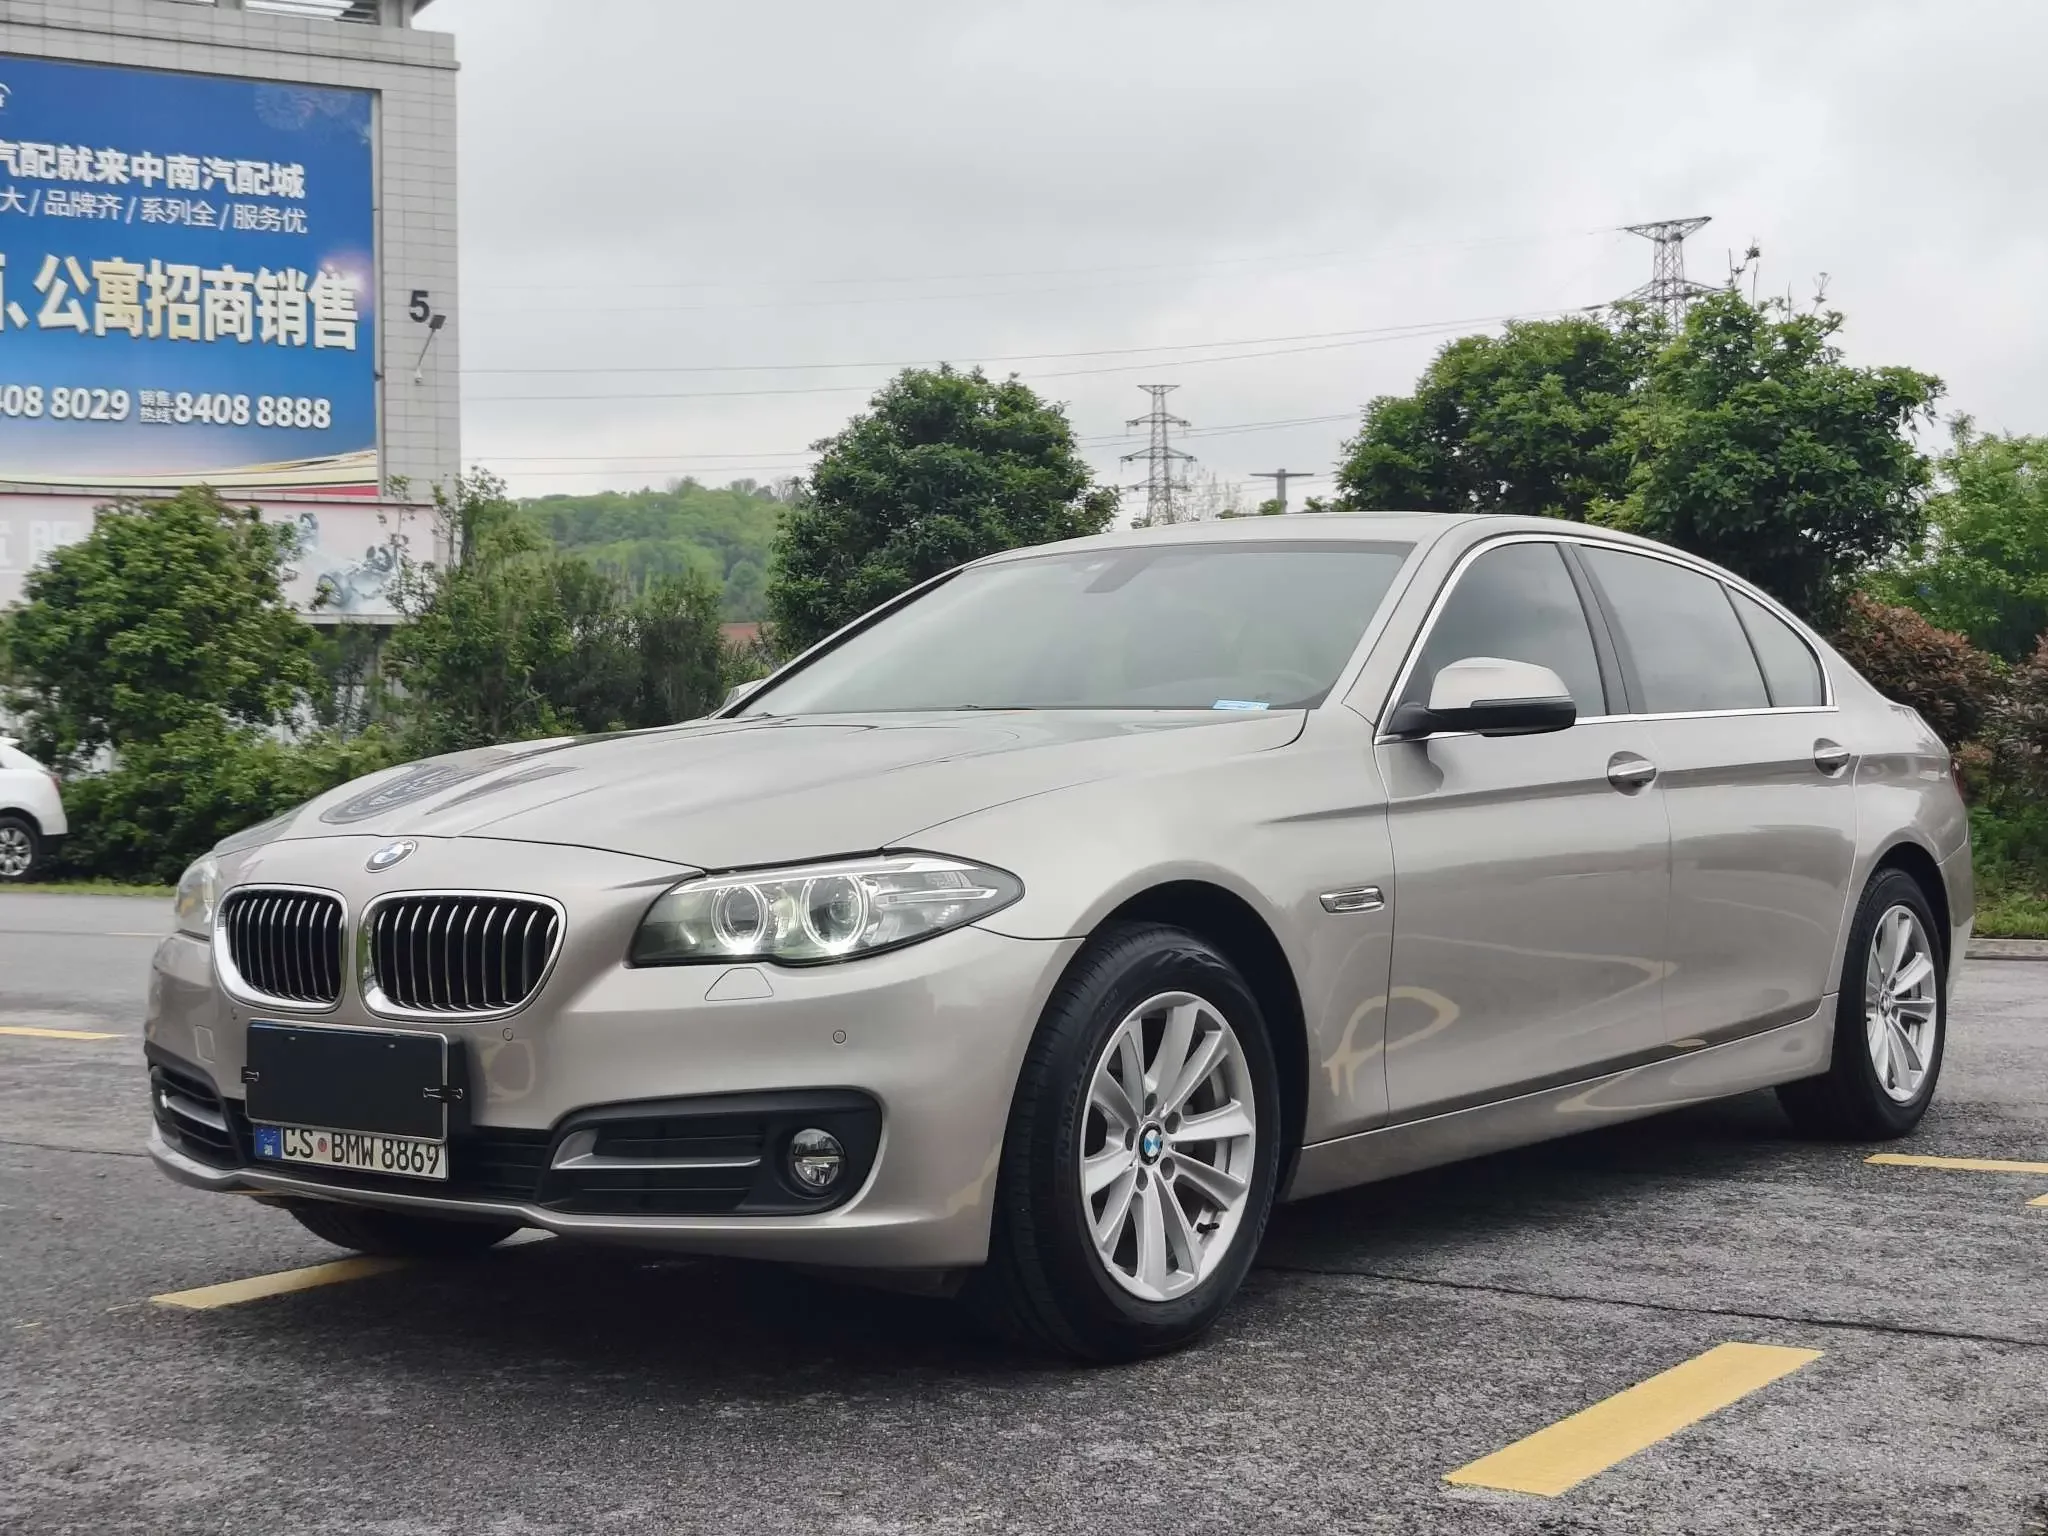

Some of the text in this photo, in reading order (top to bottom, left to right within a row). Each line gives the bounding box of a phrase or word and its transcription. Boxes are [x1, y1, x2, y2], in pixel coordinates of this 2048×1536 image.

[0, 253, 358, 350] 、公寓招商销售
[409, 289, 430, 323] 5
[0, 384, 130, 421] 08 8029
[173, 391, 331, 429] 8408 8888
[282, 1127, 440, 1174] CS BMW 8869
